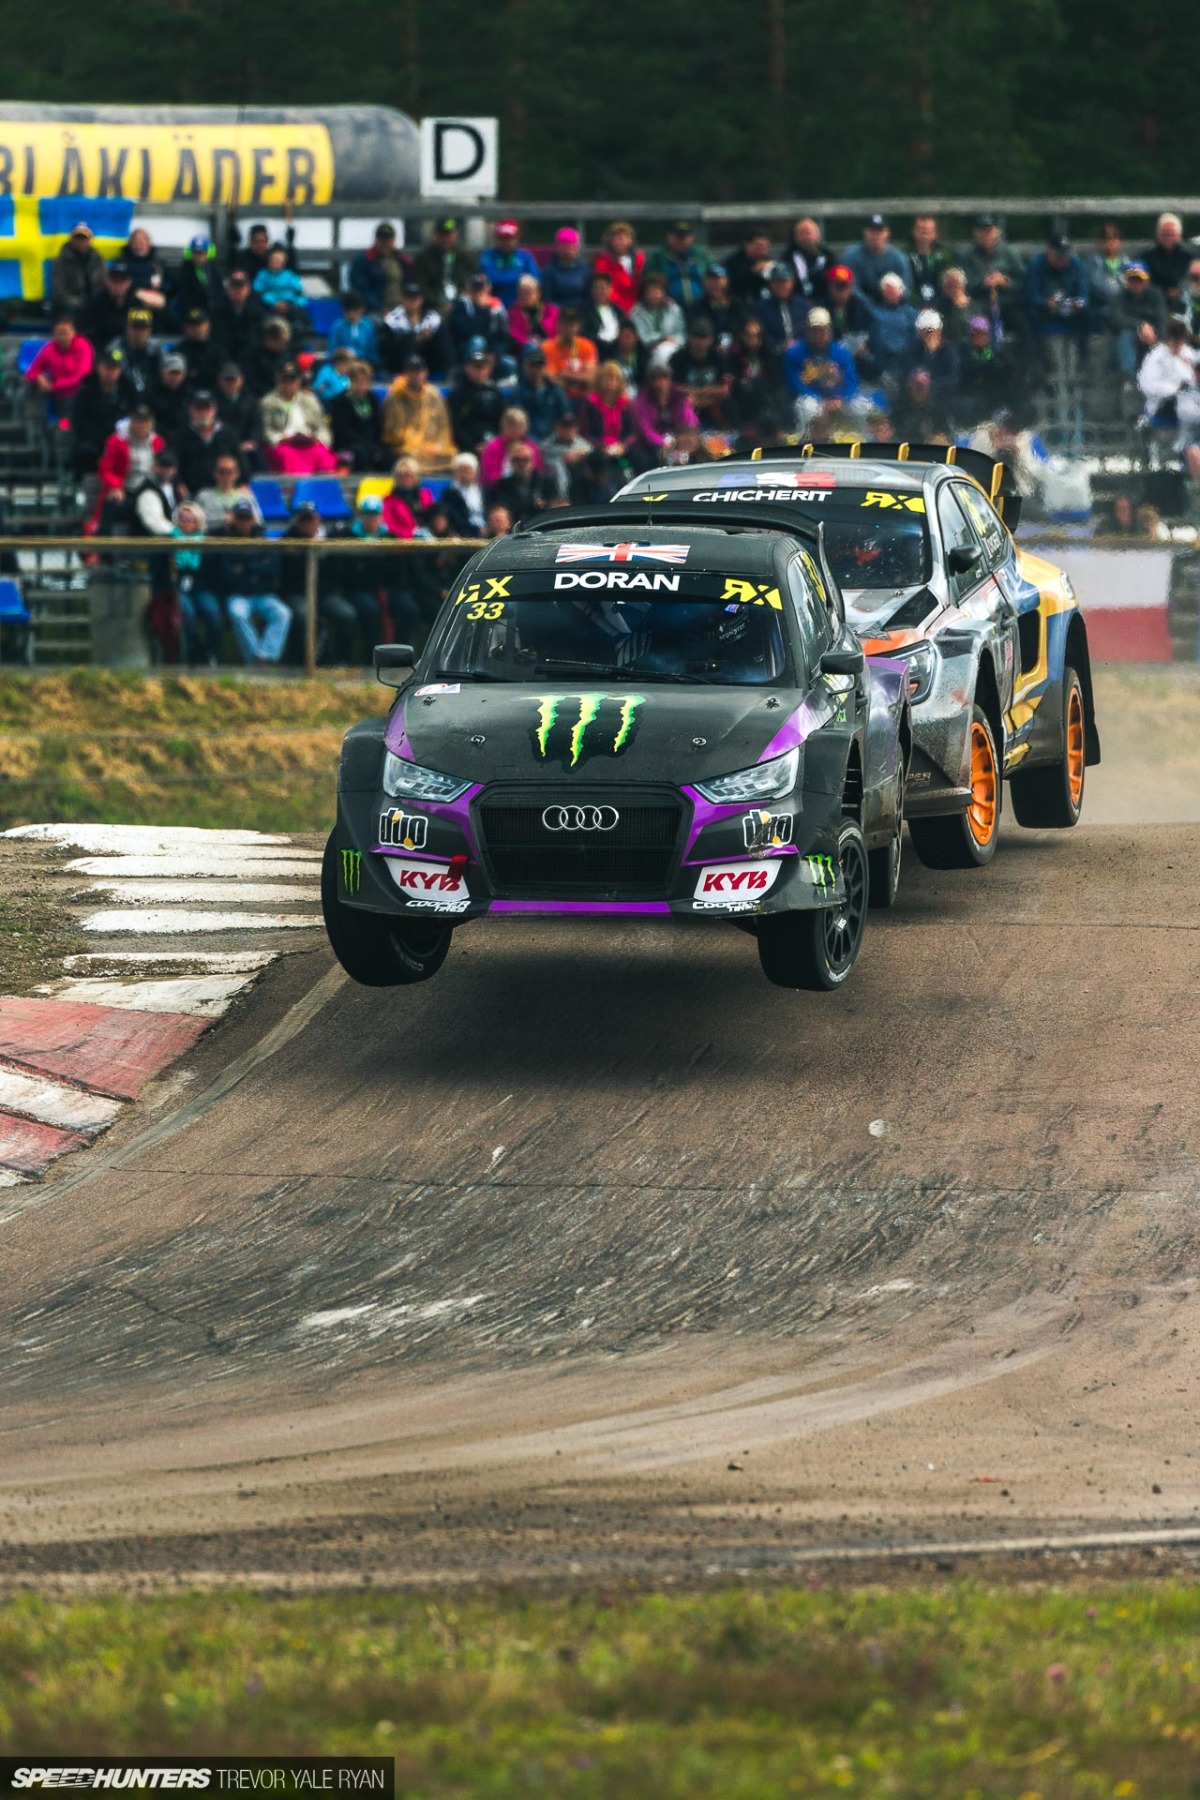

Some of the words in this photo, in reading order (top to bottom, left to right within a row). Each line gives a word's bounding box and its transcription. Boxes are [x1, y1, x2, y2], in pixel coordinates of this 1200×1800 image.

[434, 122, 486, 181] D
[692, 489, 832, 503] CHICHERIT
[553, 571, 681, 592] DORAN
[466, 602, 506, 620] 33
[399, 869, 461, 892] KYB
[702, 870, 769, 893] KYB
[405, 899, 472, 908] COOPER
